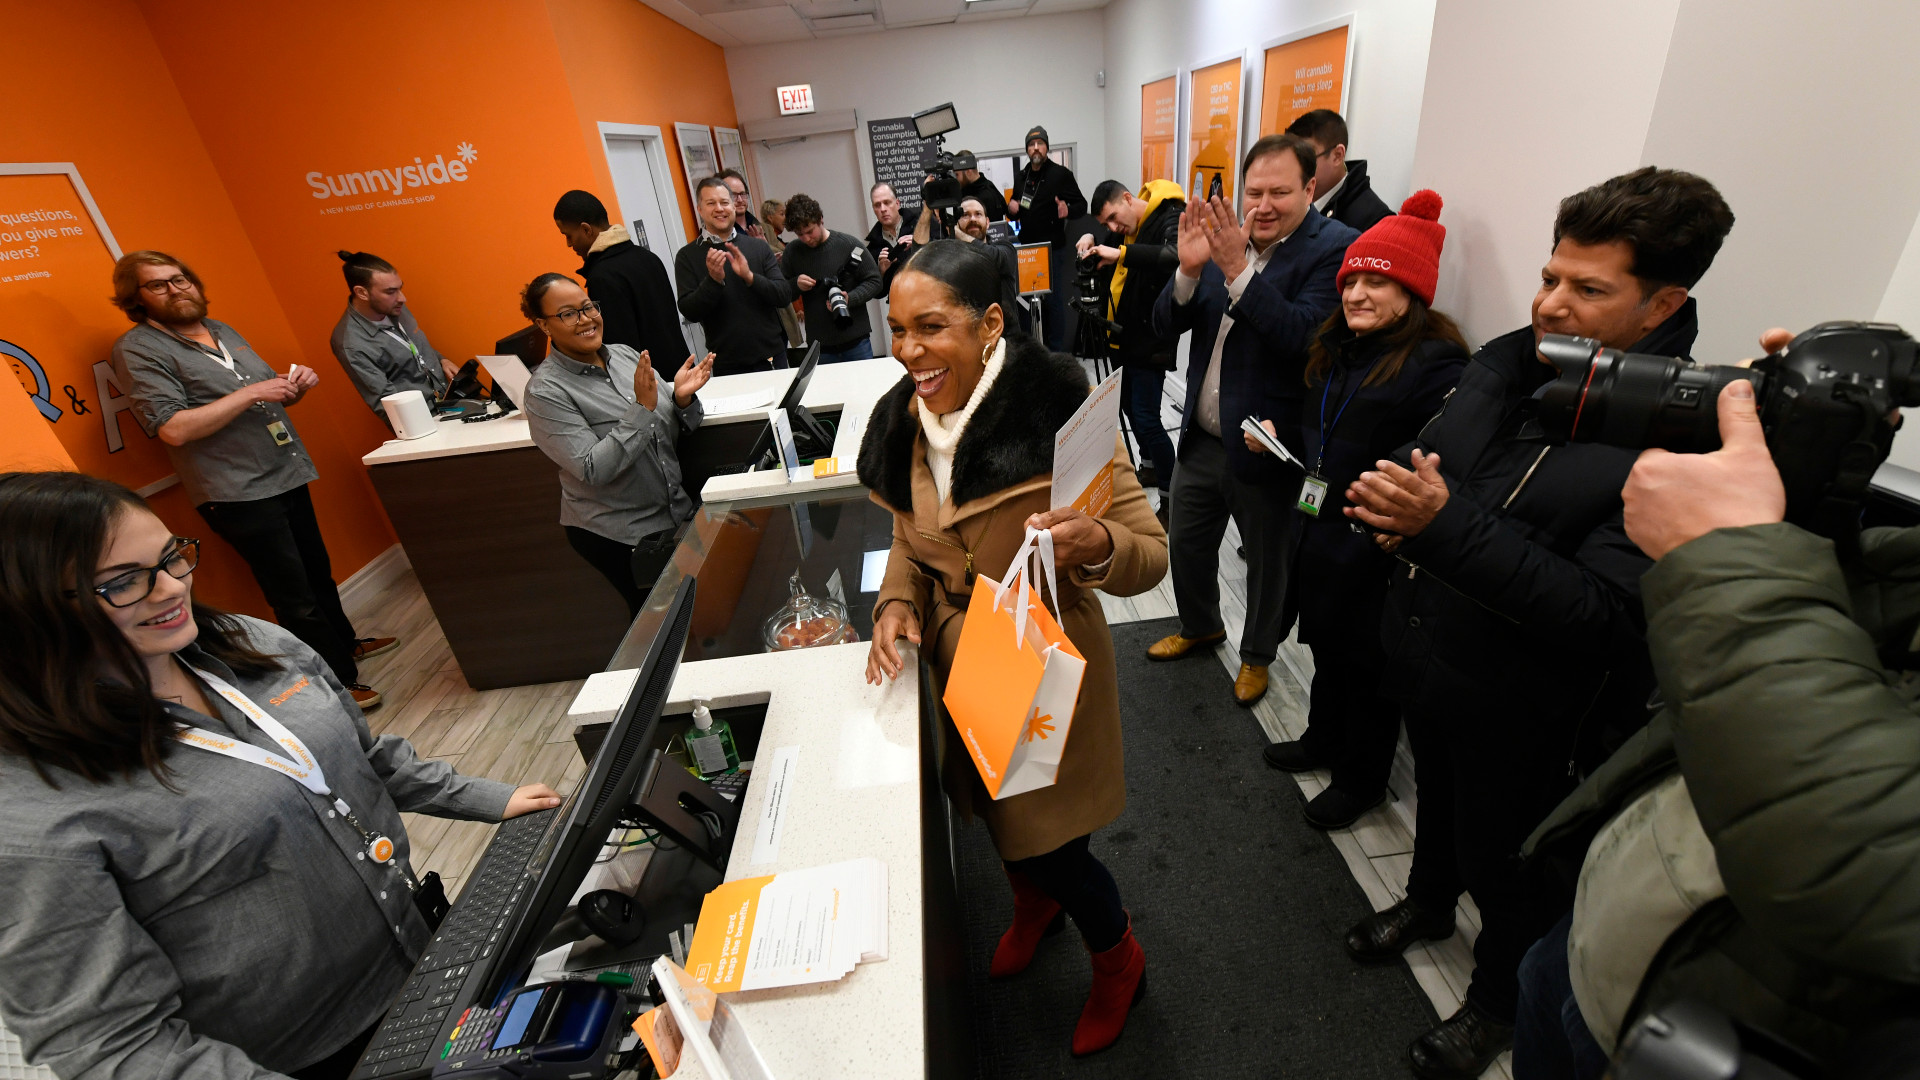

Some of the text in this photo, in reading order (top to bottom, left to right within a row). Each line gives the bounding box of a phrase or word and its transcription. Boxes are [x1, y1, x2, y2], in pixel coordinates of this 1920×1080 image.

[1307, 62, 1333, 77] cannabis
[1294, 82, 1306, 94] help
[1317, 79, 1333, 91] sleep
[781, 88, 808, 111] EXIT
[1292, 96, 1312, 109] better?
[872, 123, 905, 133] Cannabis
[874, 140, 897, 149] impair
[875, 149, 889, 157] and
[890, 146, 917, 157] driving,
[876, 157, 887, 165] for
[888, 154, 906, 163] adult
[877, 163, 894, 172] only,
[895, 163, 910, 171] may
[878, 170, 896, 180] habit
[306, 154, 468, 199] Sunnyside
[894, 177, 917, 187] should
[904, 185, 921, 194] used
[326, 206, 344, 215] NEW
[345, 203, 363, 213] KIND
[364, 202, 375, 210] OF
[376, 197, 415, 208] CANNABIS
[415, 194, 436, 204] SHOP
[1, 208, 78, 227] questions,
[0, 225, 84, 246] ou give me
[0, 245, 40, 262] wers?
[1348, 256, 1392, 271] POLITICO
[2, 270, 52, 283] us anything.
[63, 385, 92, 415] &
[92, 359, 160, 454] A
[226, 690, 263, 719] Sunnyside
[284, 738, 314, 771] Sunnyside
[264, 756, 305, 779] Sunnyside
[713, 911, 737, 984] Keep your card.
[724, 898, 750, 982] Reap the benefits.
